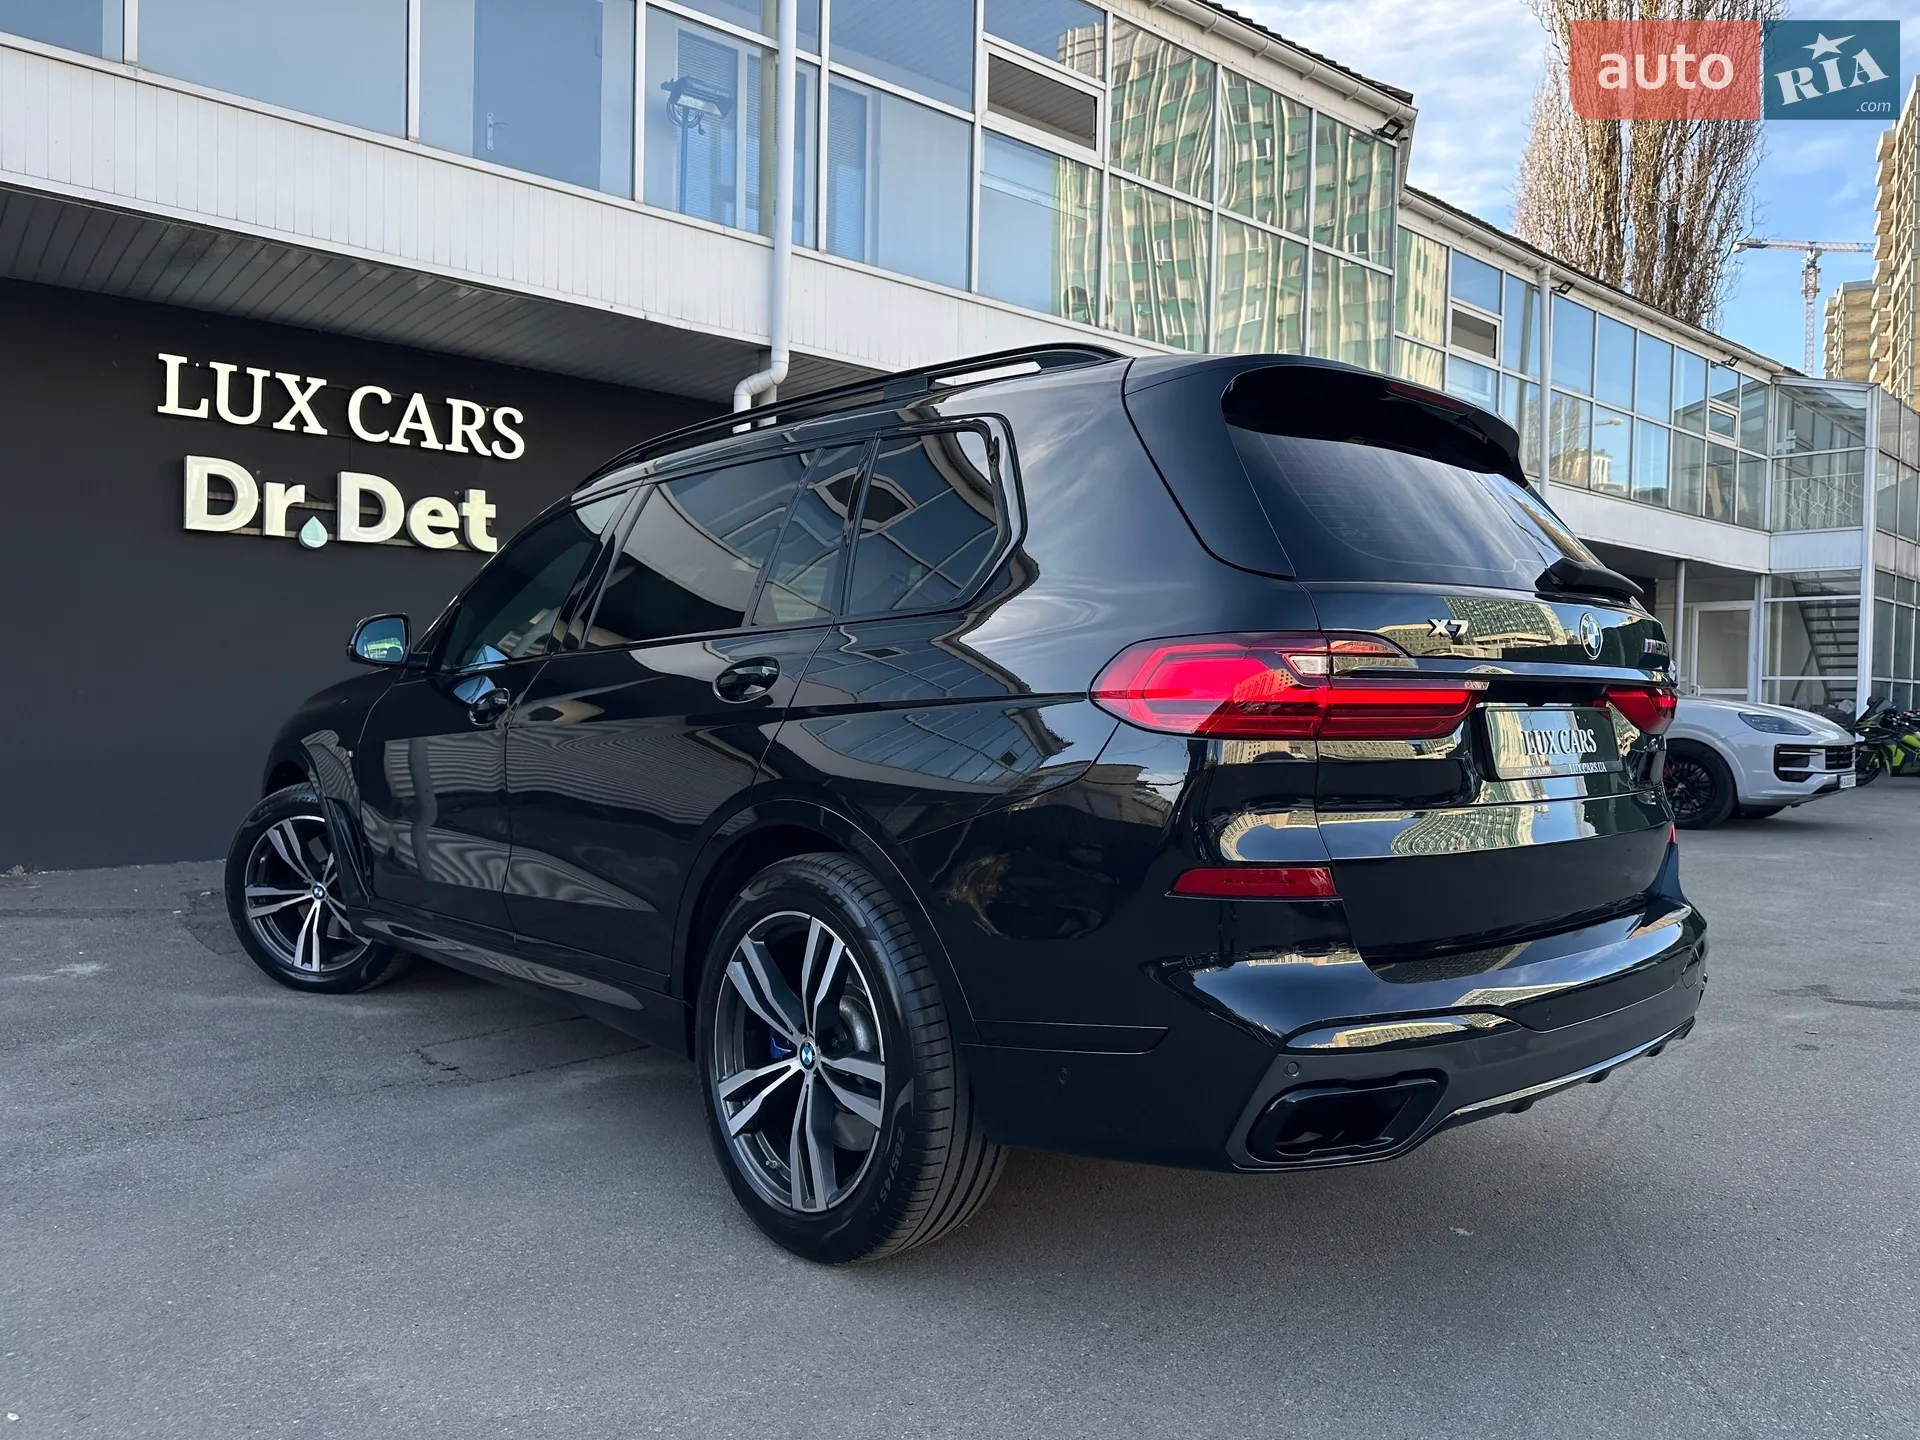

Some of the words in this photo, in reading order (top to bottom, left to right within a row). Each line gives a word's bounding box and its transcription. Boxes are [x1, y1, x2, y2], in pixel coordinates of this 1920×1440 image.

[157, 353, 328, 436] LUX
[347, 385, 525, 460] CARS
[1427, 618, 1469, 638] X7
[1522, 729, 1559, 755] LUX
[1559, 728, 1597, 754] CARS
